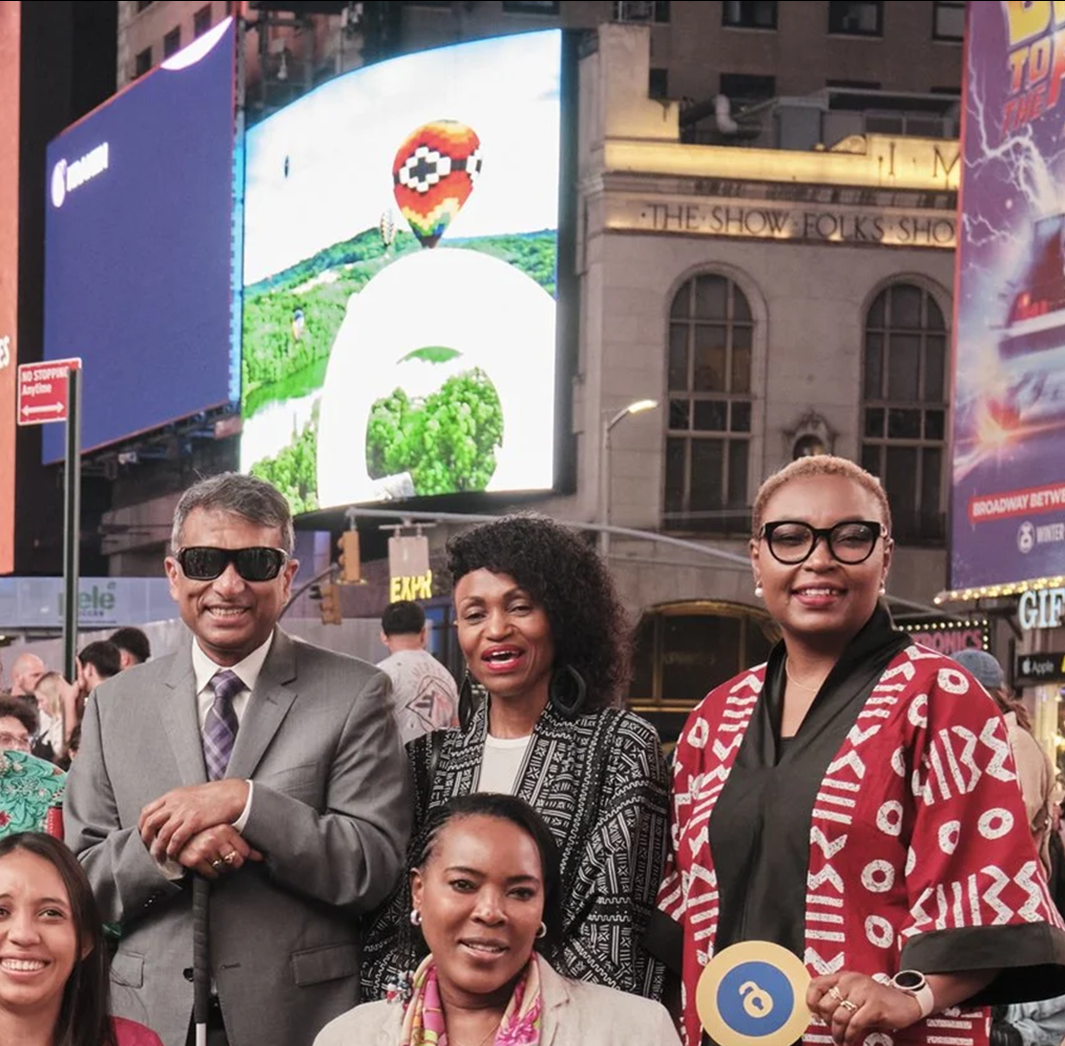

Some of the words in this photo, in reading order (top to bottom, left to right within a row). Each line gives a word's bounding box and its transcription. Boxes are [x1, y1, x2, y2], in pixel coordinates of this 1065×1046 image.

[1009, 40, 1051, 93] TO
[1001, 85, 1045, 136] THE
[647, 204, 700, 230] THE
[710, 208, 788, 235] SHOW
[803, 214, 884, 241] FOLKS
[22, 370, 33, 382] NO
[22, 382, 52, 397] Anytime
[973, 493, 1029, 517] BROADWAY
[1032, 660, 1055, 676] Apple
